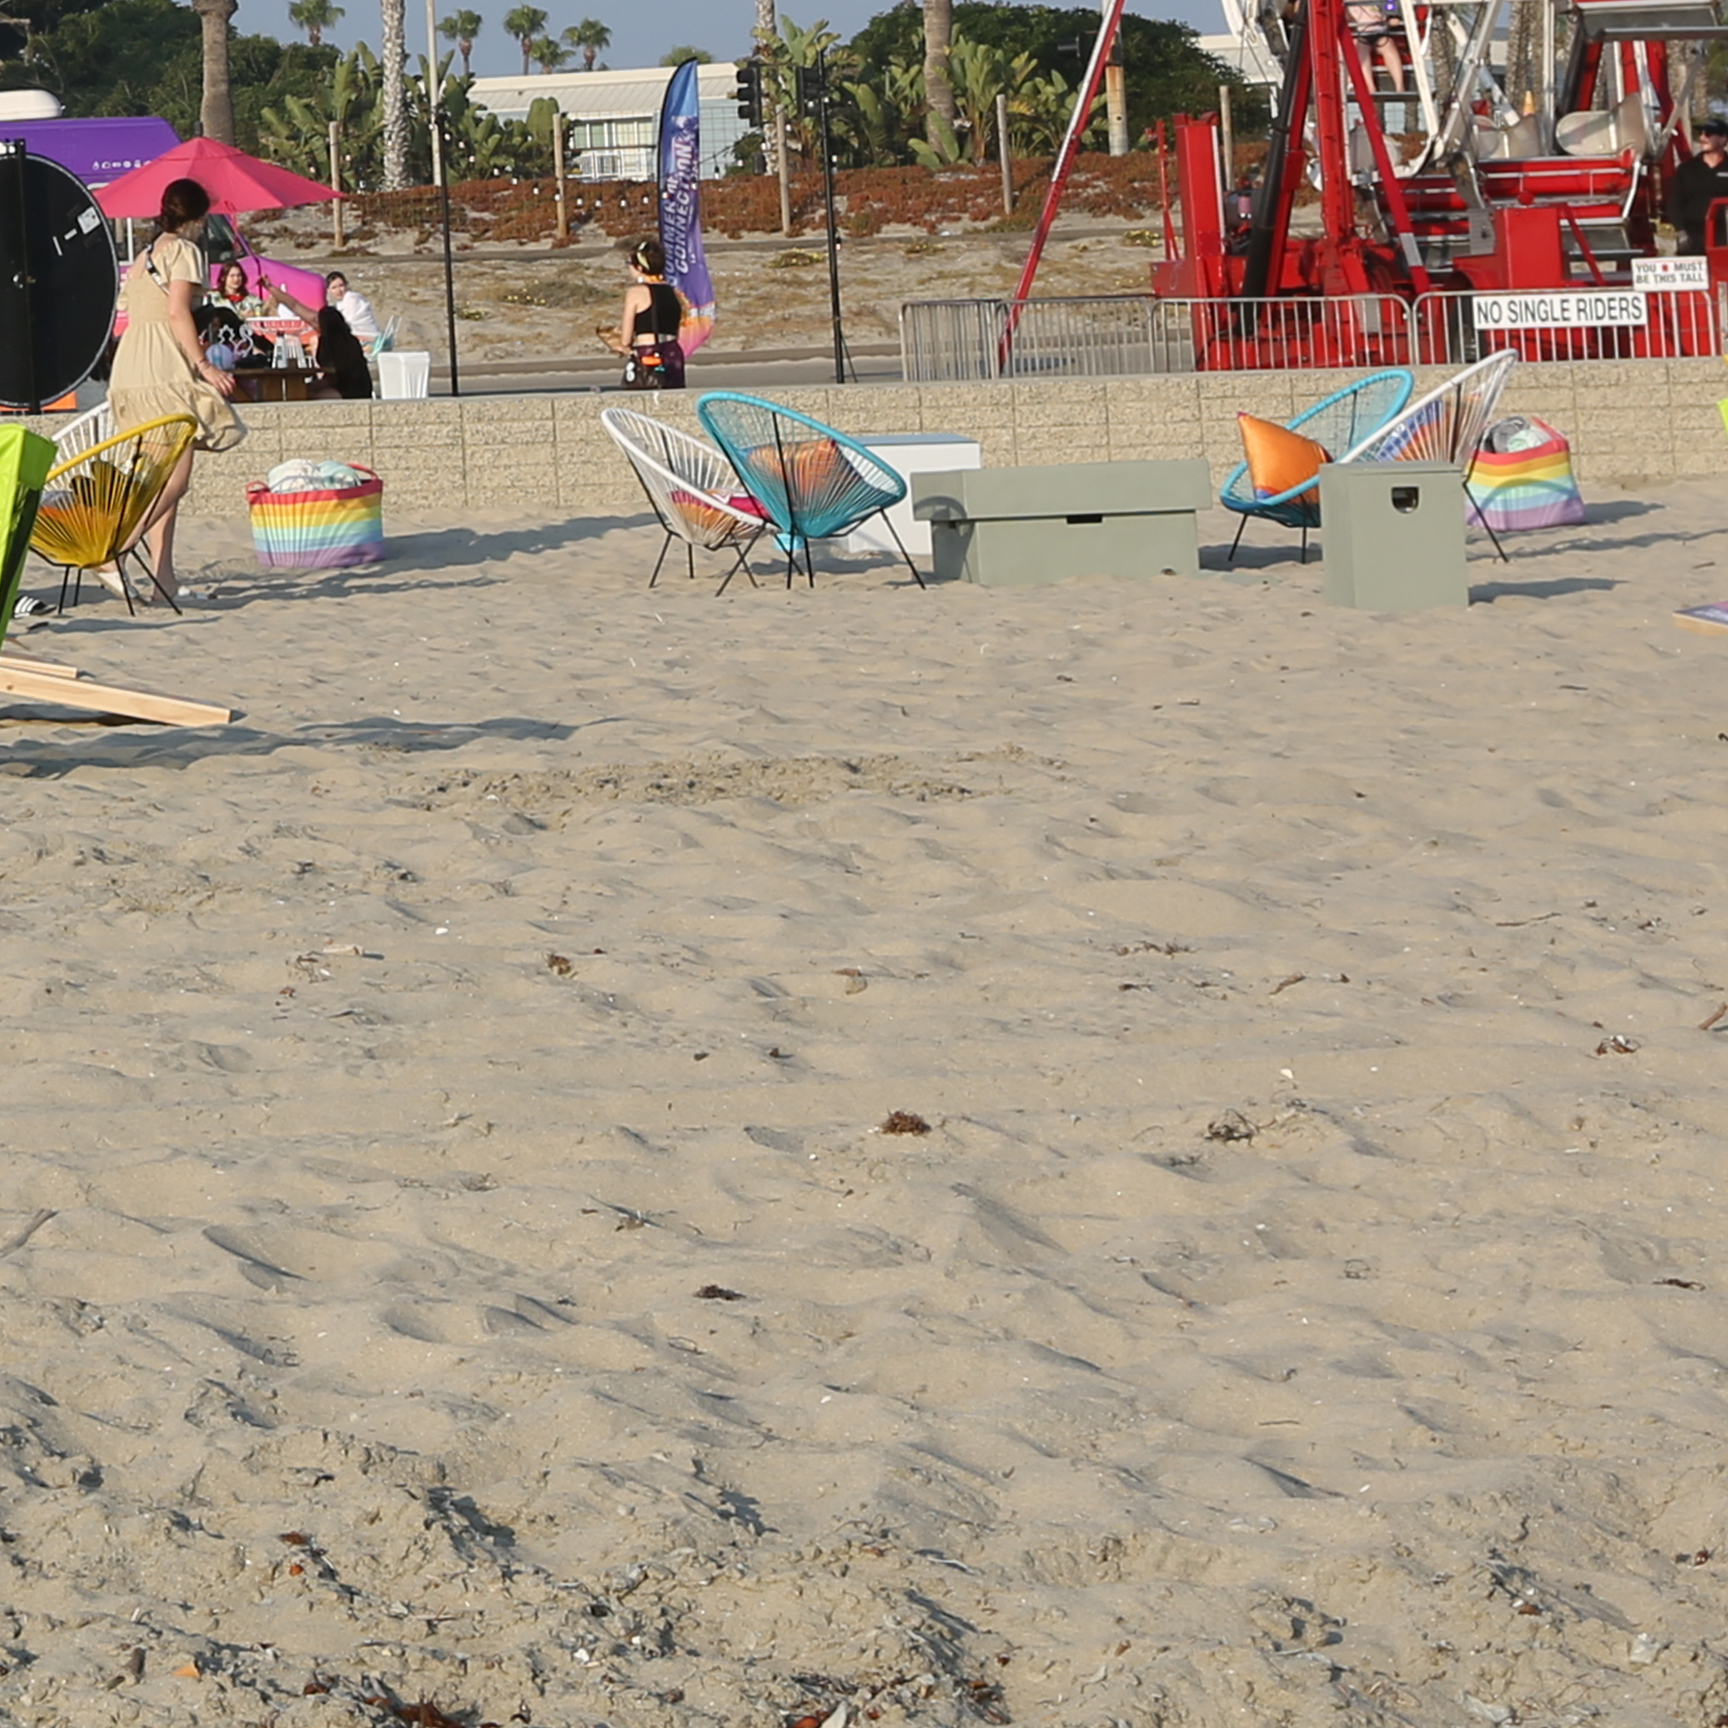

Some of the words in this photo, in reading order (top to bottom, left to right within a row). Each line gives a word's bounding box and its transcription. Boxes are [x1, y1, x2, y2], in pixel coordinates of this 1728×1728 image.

[1636, 263, 1657, 273] YOU
[1674, 261, 1704, 272] MUST
[1636, 274, 1649, 284] BE
[1653, 273, 1676, 284] THIS
[1680, 272, 1704, 283] TALL
[1476, 300, 1502, 324] NO
[1507, 298, 1571, 324] SINGLE
[1576, 296, 1643, 321] RIDERS
